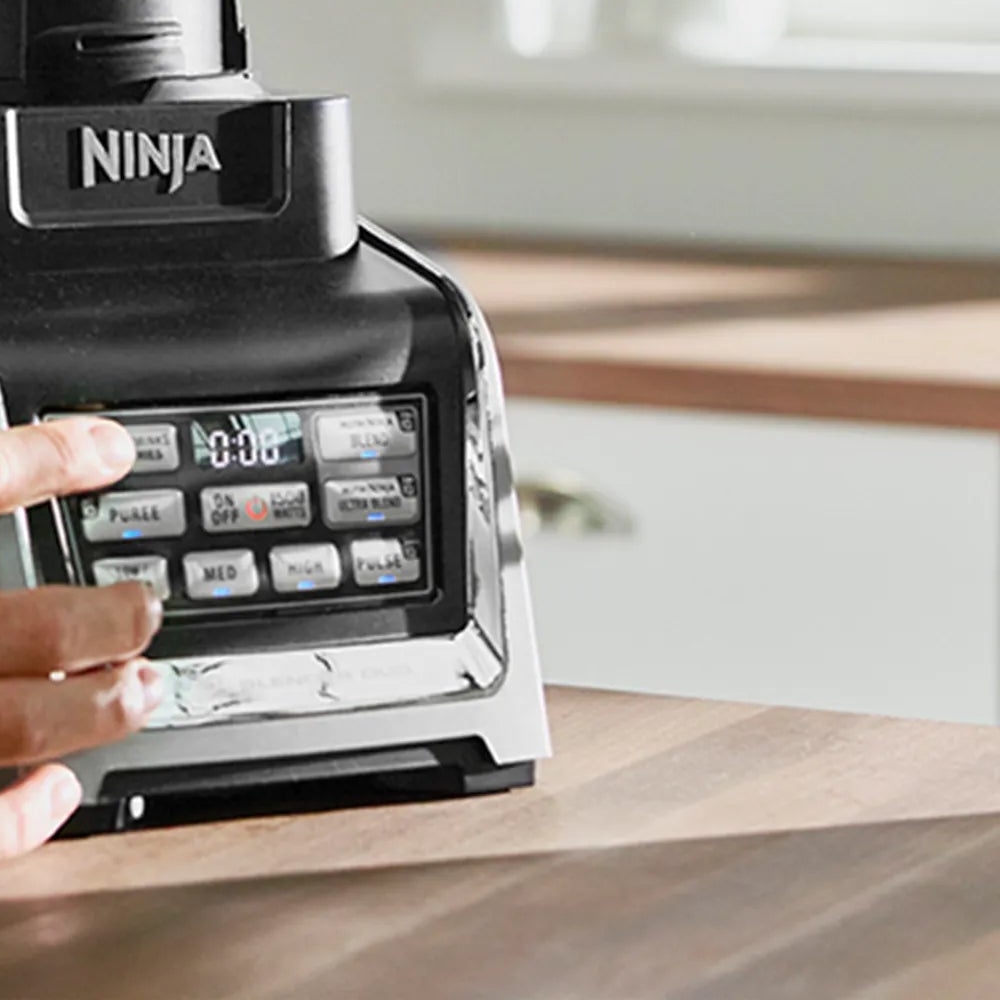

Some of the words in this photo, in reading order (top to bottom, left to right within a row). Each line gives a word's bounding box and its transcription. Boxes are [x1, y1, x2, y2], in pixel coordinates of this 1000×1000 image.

[81, 125, 222, 194] NINJA
[213, 493, 235, 508] ON
[109, 505, 161, 524] PUREE
[210, 508, 240, 526] OFF
[287, 559, 324, 576] HIGH
[357, 554, 403, 572] PULSE
[203, 564, 238, 583] MED
